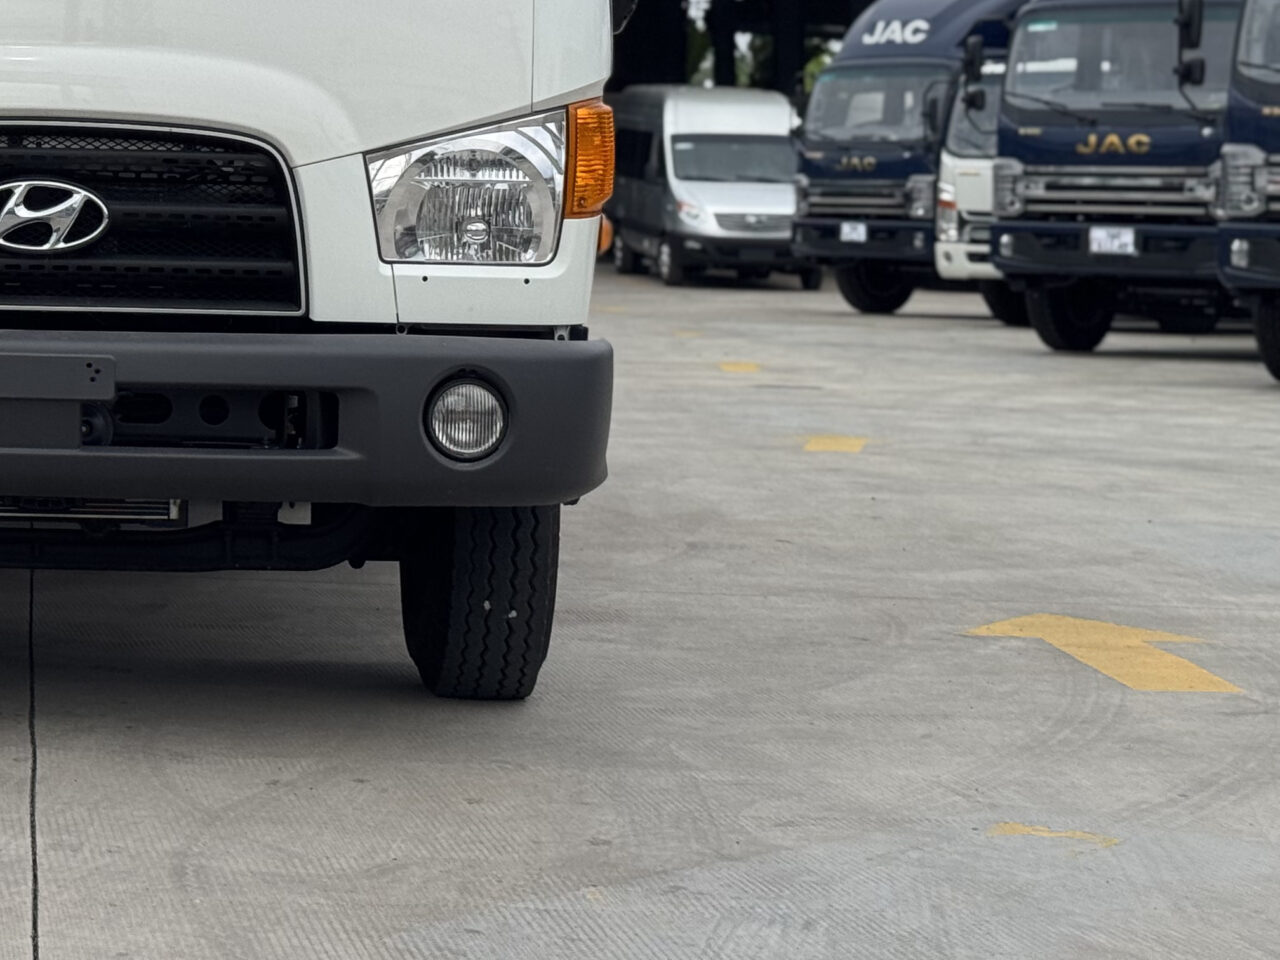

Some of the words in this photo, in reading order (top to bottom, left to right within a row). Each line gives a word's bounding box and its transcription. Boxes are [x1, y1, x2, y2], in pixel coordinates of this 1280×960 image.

[862, 19, 930, 45] JAC
[1075, 133, 1151, 155] JAC
[834, 155, 877, 172] JAC
